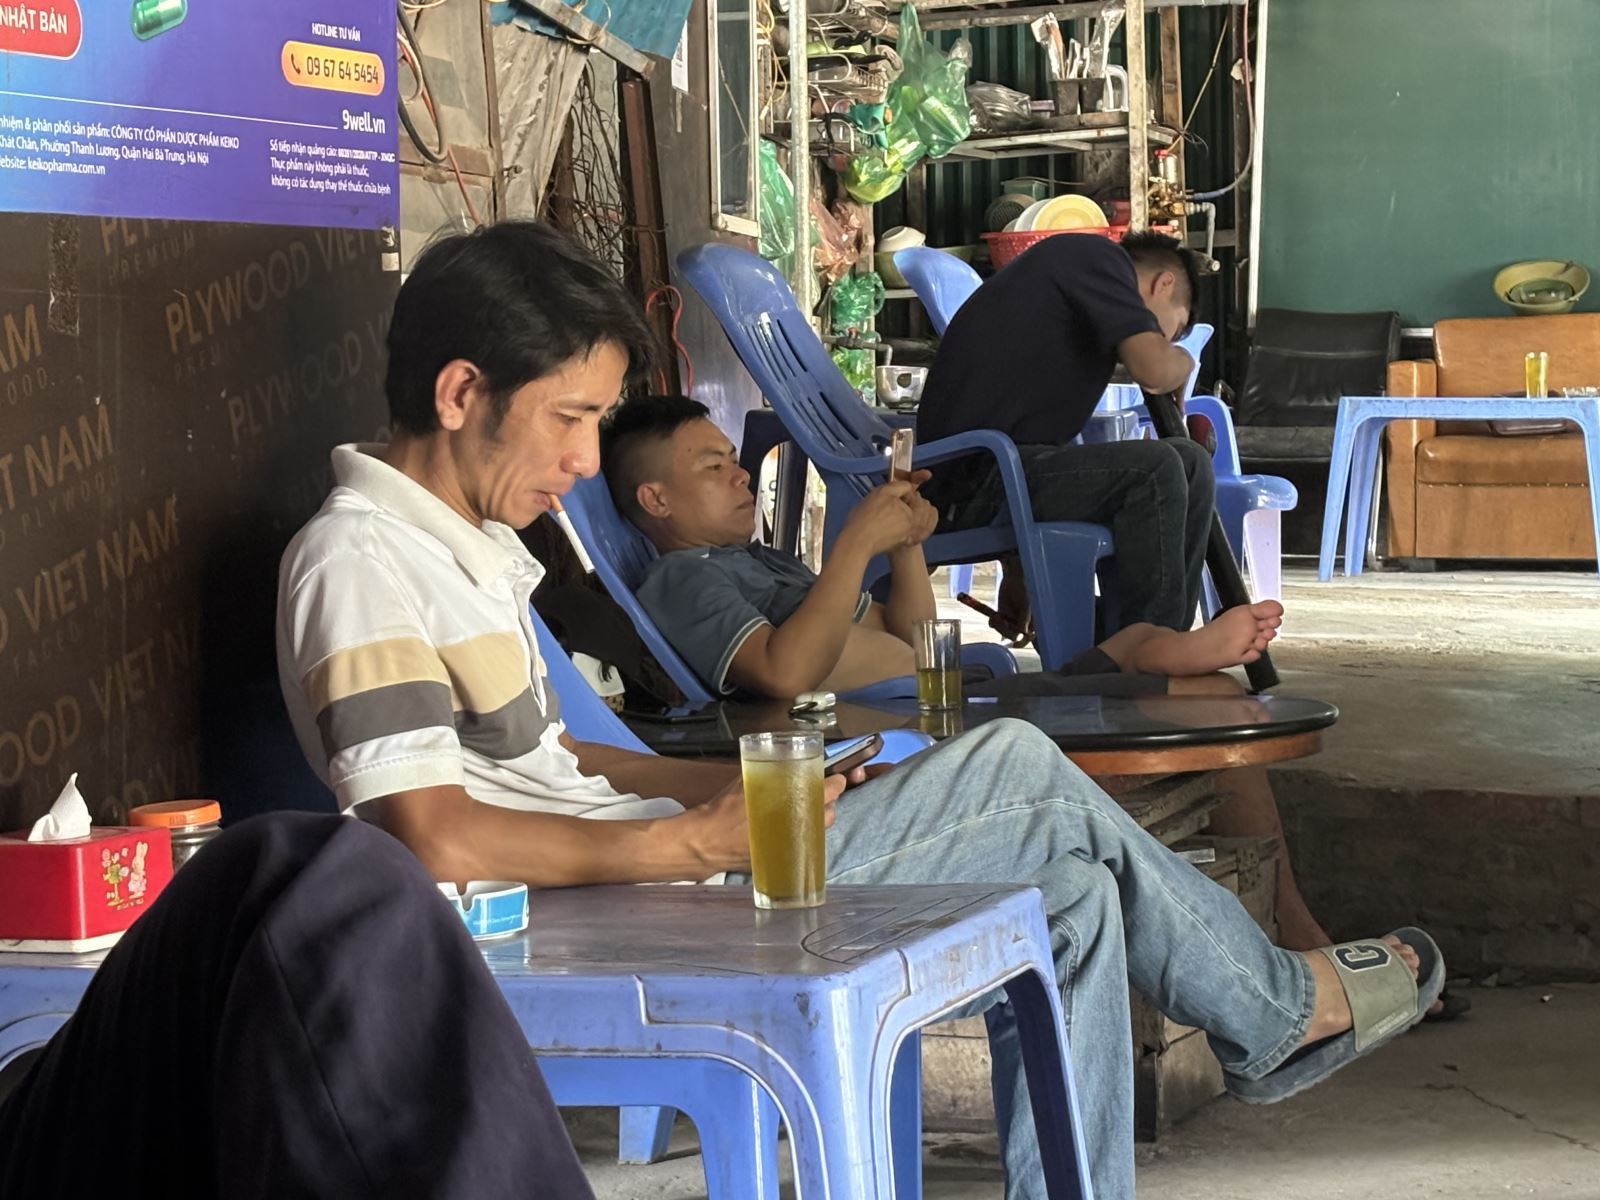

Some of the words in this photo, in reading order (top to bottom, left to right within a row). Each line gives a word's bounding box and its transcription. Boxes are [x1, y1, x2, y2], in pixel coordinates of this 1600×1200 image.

[0, 3, 36, 35] NHẬT
[39, 7, 68, 35] BẢN
[311, 22, 338, 39] HOTLINE
[306, 55, 321, 76] 09
[323, 58, 335, 78] 67
[338, 60, 351, 80] 64
[354, 62, 379, 84] 5454
[25, 117, 31, 130] &
[111, 124, 133, 140] CÔNG
[133, 128, 143, 141] TY
[220, 136, 240, 149] KEIKO
[27, 156, 106, 175] keikopharma.com.vn
[70, 140, 95, 155] Thanh
[142, 147, 154, 160] Hai
[164, 240, 311, 356] PLYWOOD
[23, 402, 115, 498] NAM
[13, 548, 90, 635] VIET
[96, 495, 180, 592] NAM
